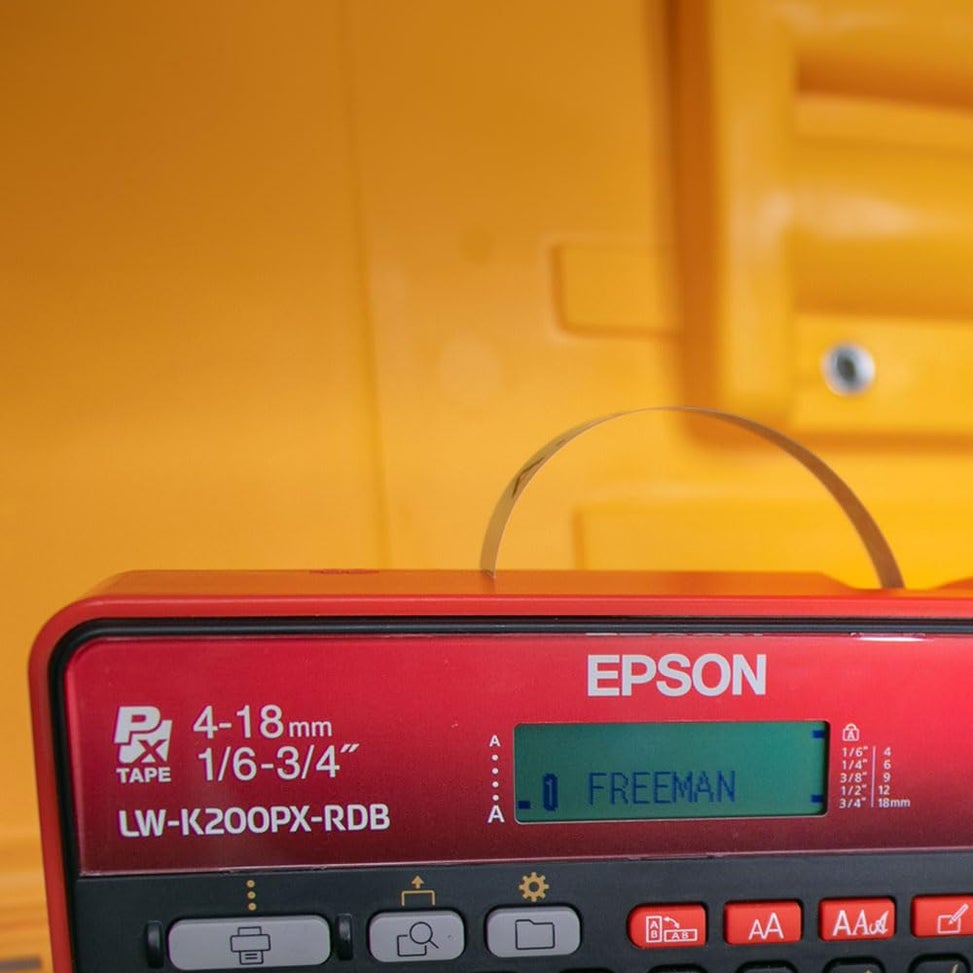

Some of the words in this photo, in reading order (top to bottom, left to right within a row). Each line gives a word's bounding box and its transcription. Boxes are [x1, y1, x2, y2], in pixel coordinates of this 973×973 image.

[587, 652, 767, 697] EPSON
[489, 734, 501, 747] A
[883, 746, 892, 758] 4
[883, 759, 892, 770] 6
[115, 766, 172, 784] TAPE
[883, 772, 891, 783] 9
[588, 770, 736, 805] FREEMAN
[878, 784, 891, 796] 12
[878, 797, 911, 809] 18mm
[119, 803, 391, 838] LW-K200PX-RDB
[487, 804, 505, 824] A
